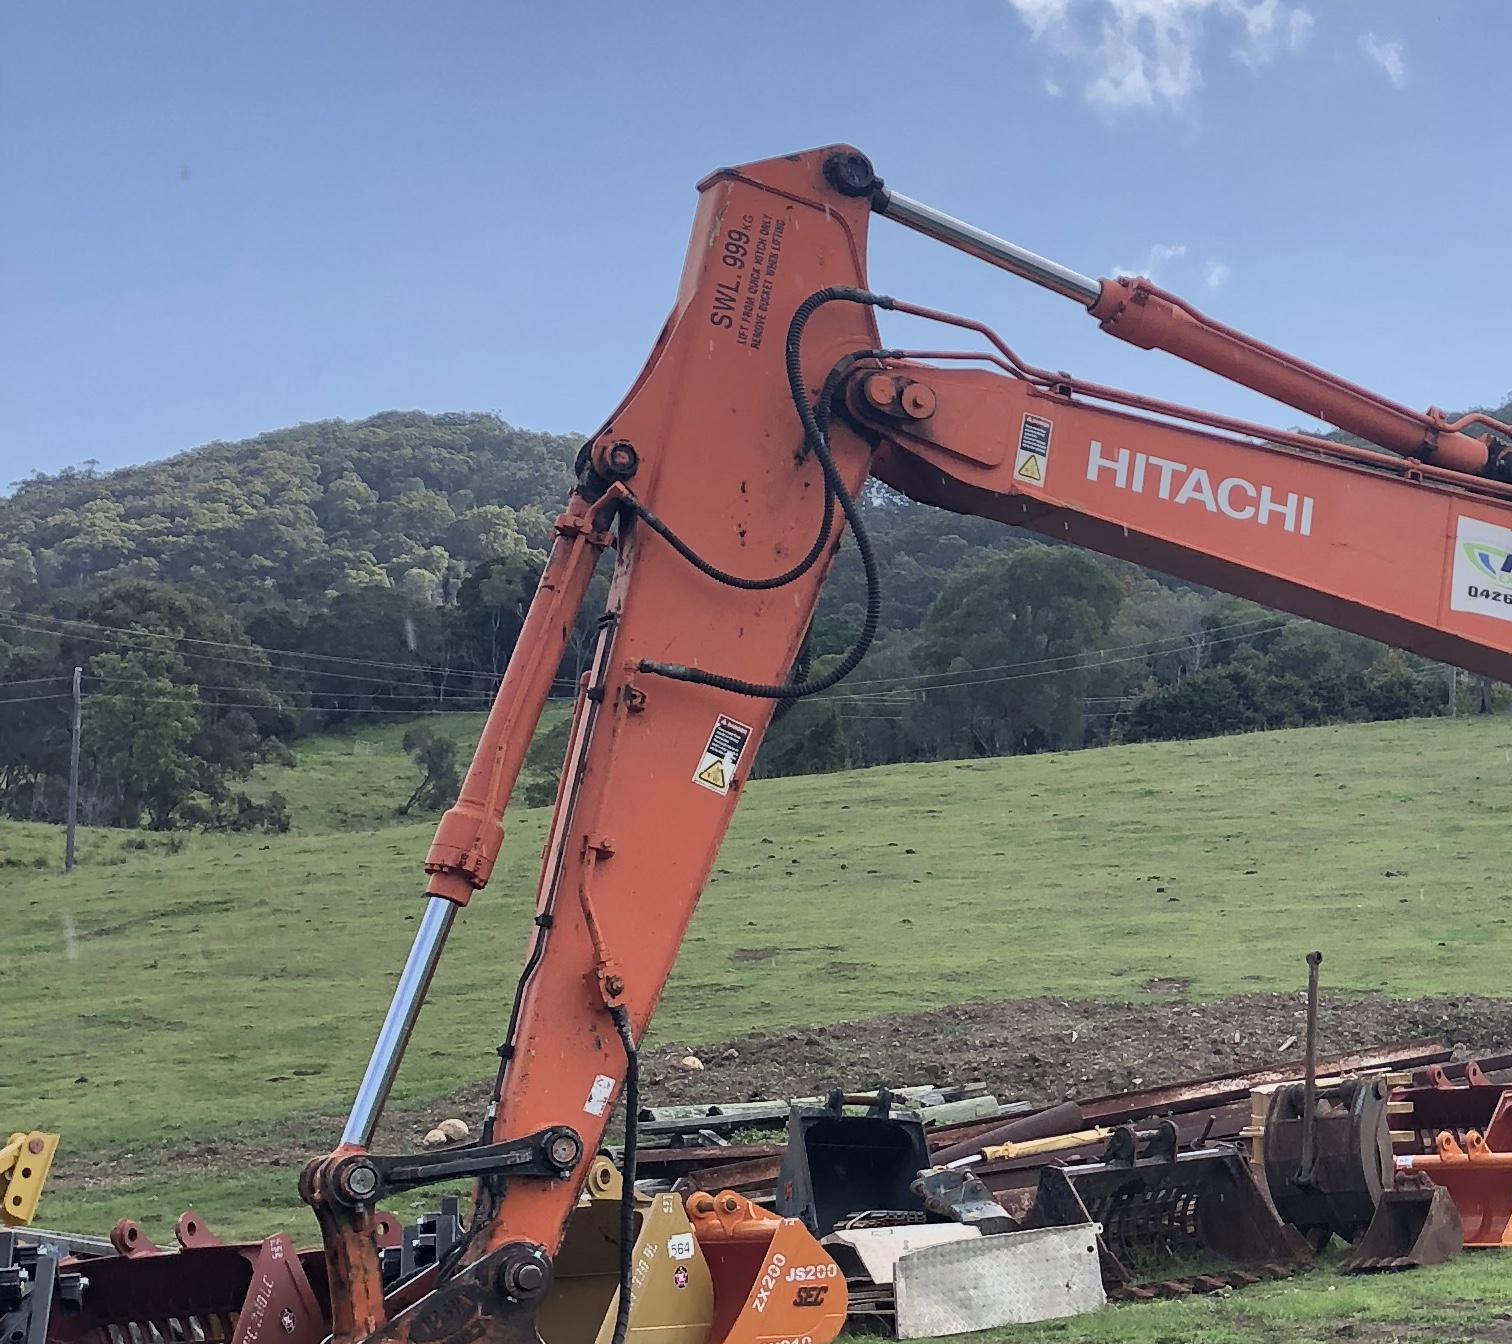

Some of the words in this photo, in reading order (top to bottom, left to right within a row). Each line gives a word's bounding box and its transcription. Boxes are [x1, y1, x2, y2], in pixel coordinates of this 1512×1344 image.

[760, 214, 773, 236] ONLY
[771, 219, 786, 251] LIFTING
[754, 239, 767, 266] HITCH
[766, 253, 778, 276] WHEN
[748, 267, 761, 294] QUICK
[758, 279, 773, 312] BUCKET
[742, 297, 755, 324] FROM
[737, 325, 749, 345] LIFT
[750, 313, 766, 350] REMOVE
[1086, 440, 1314, 536] HITACHI
[1468, 585, 1512, 605] 0426
[752, 1253, 786, 1312] ZX200
[785, 1263, 837, 1282] JS200
